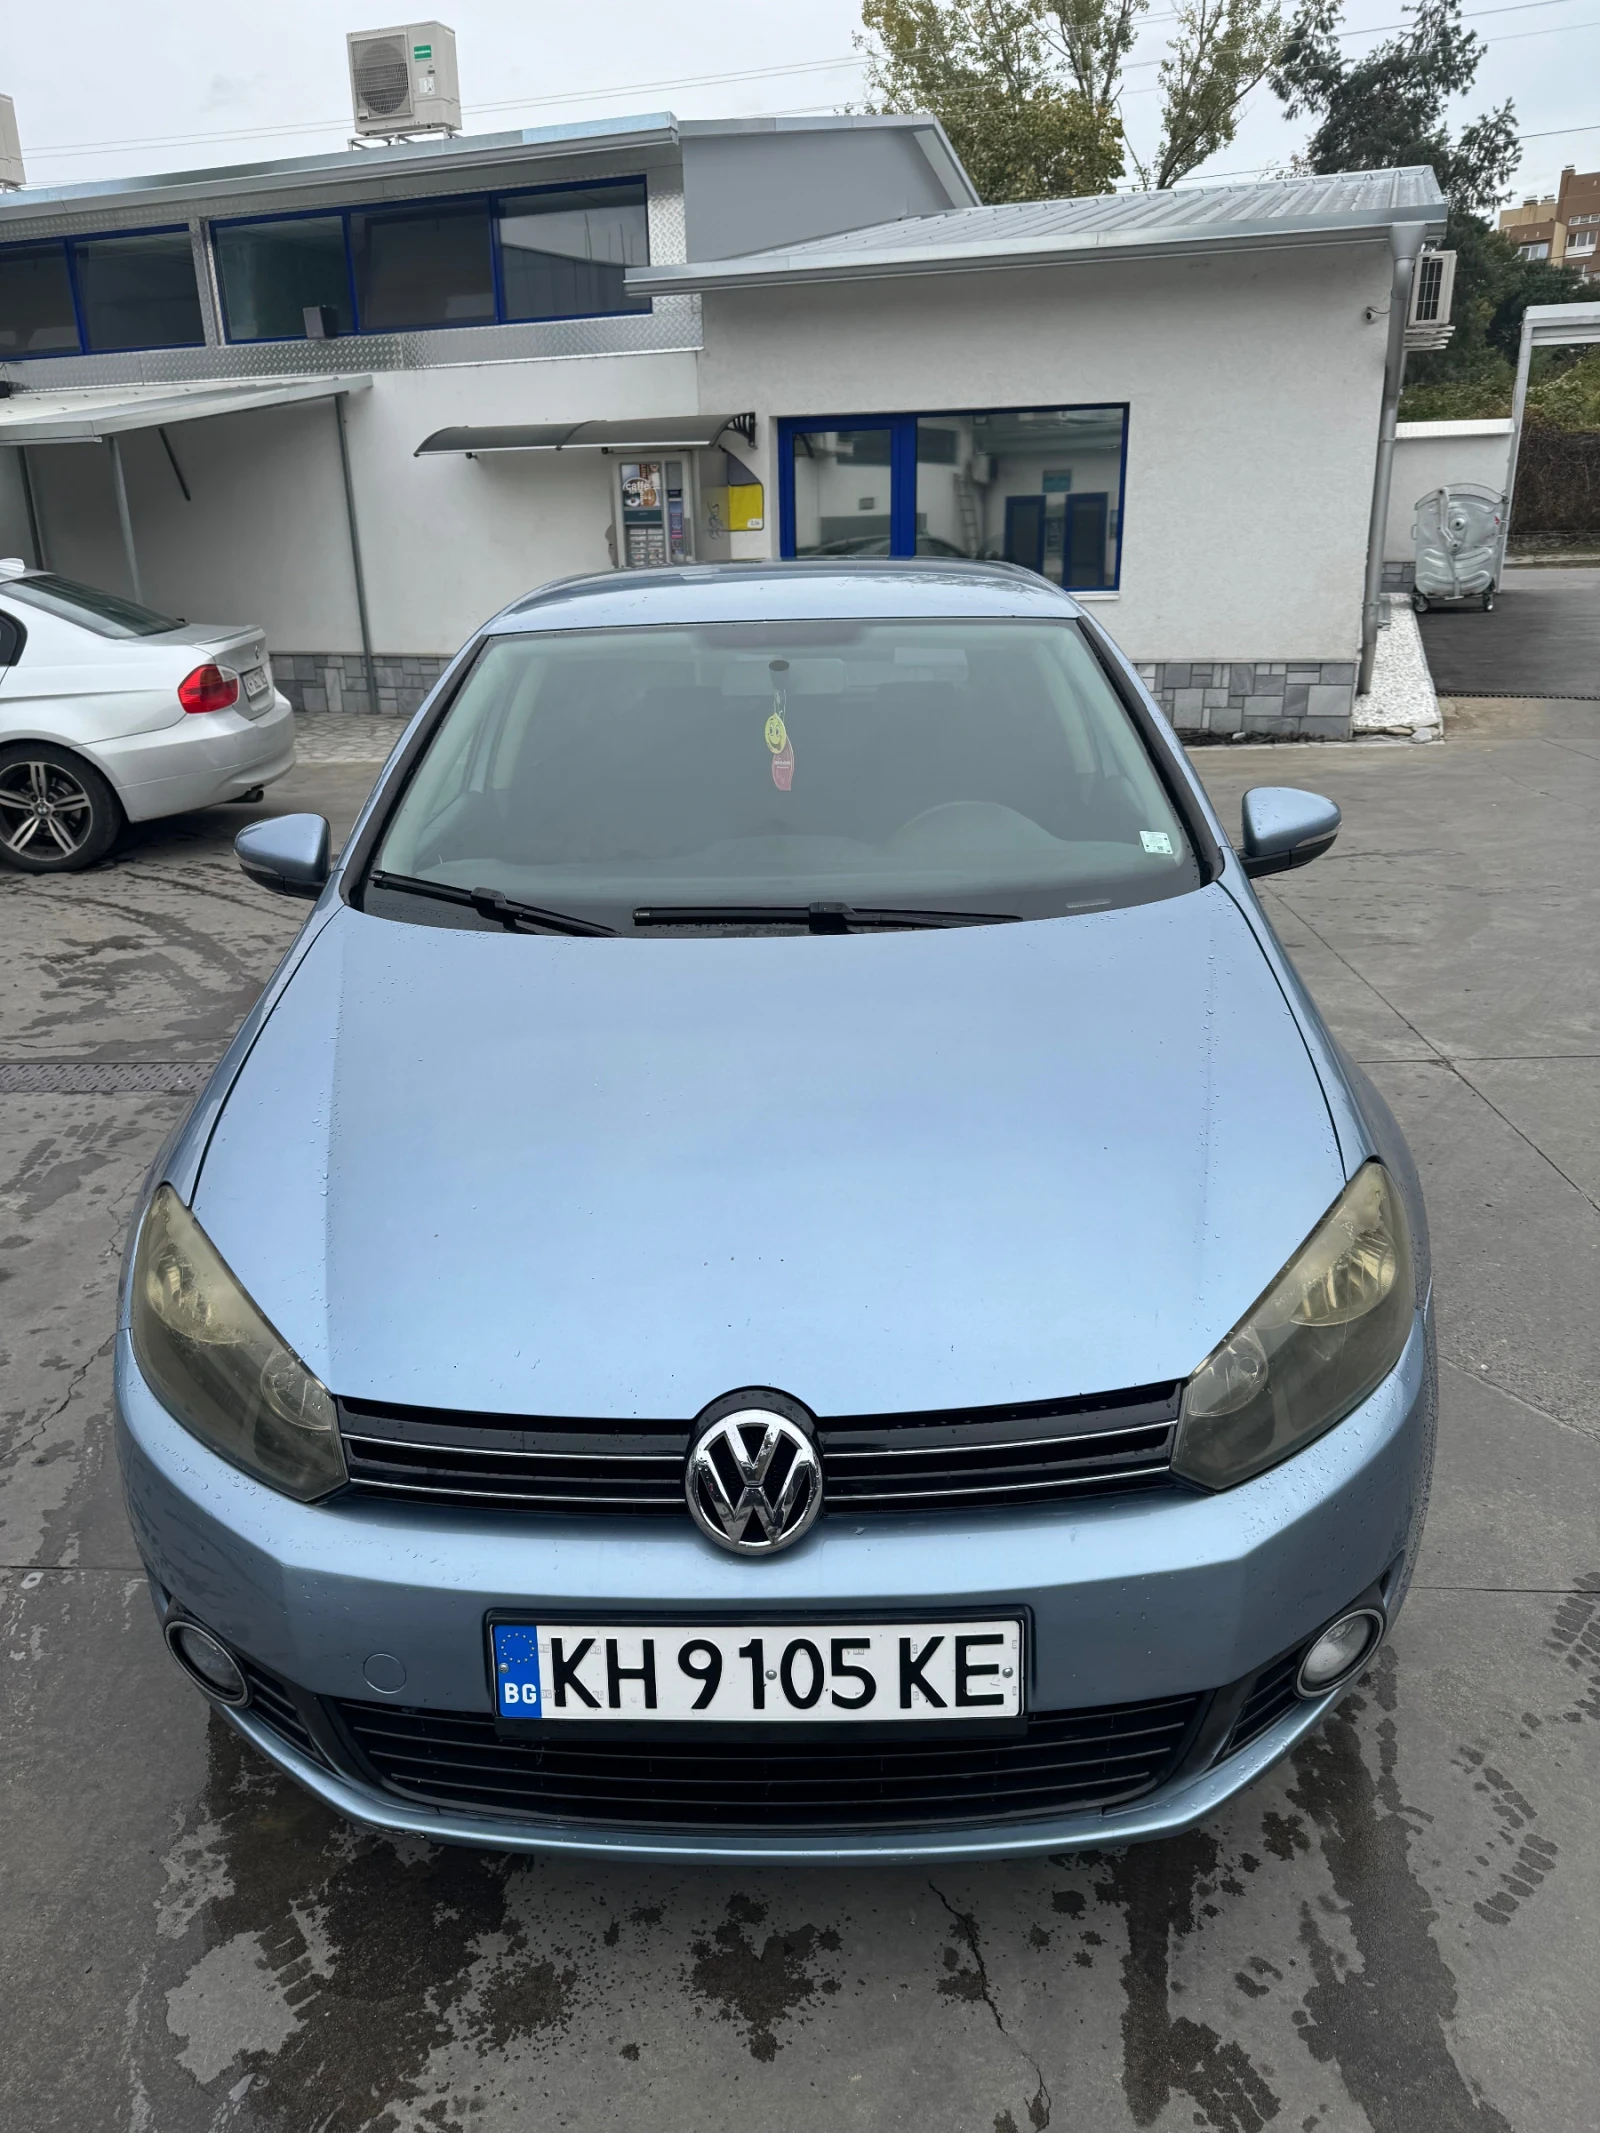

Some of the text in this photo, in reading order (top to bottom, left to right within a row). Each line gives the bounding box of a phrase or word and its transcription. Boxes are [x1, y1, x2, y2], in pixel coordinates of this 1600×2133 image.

[504, 1683, 537, 1704] BG
[551, 1633, 1004, 1709] KH 9105 KE
